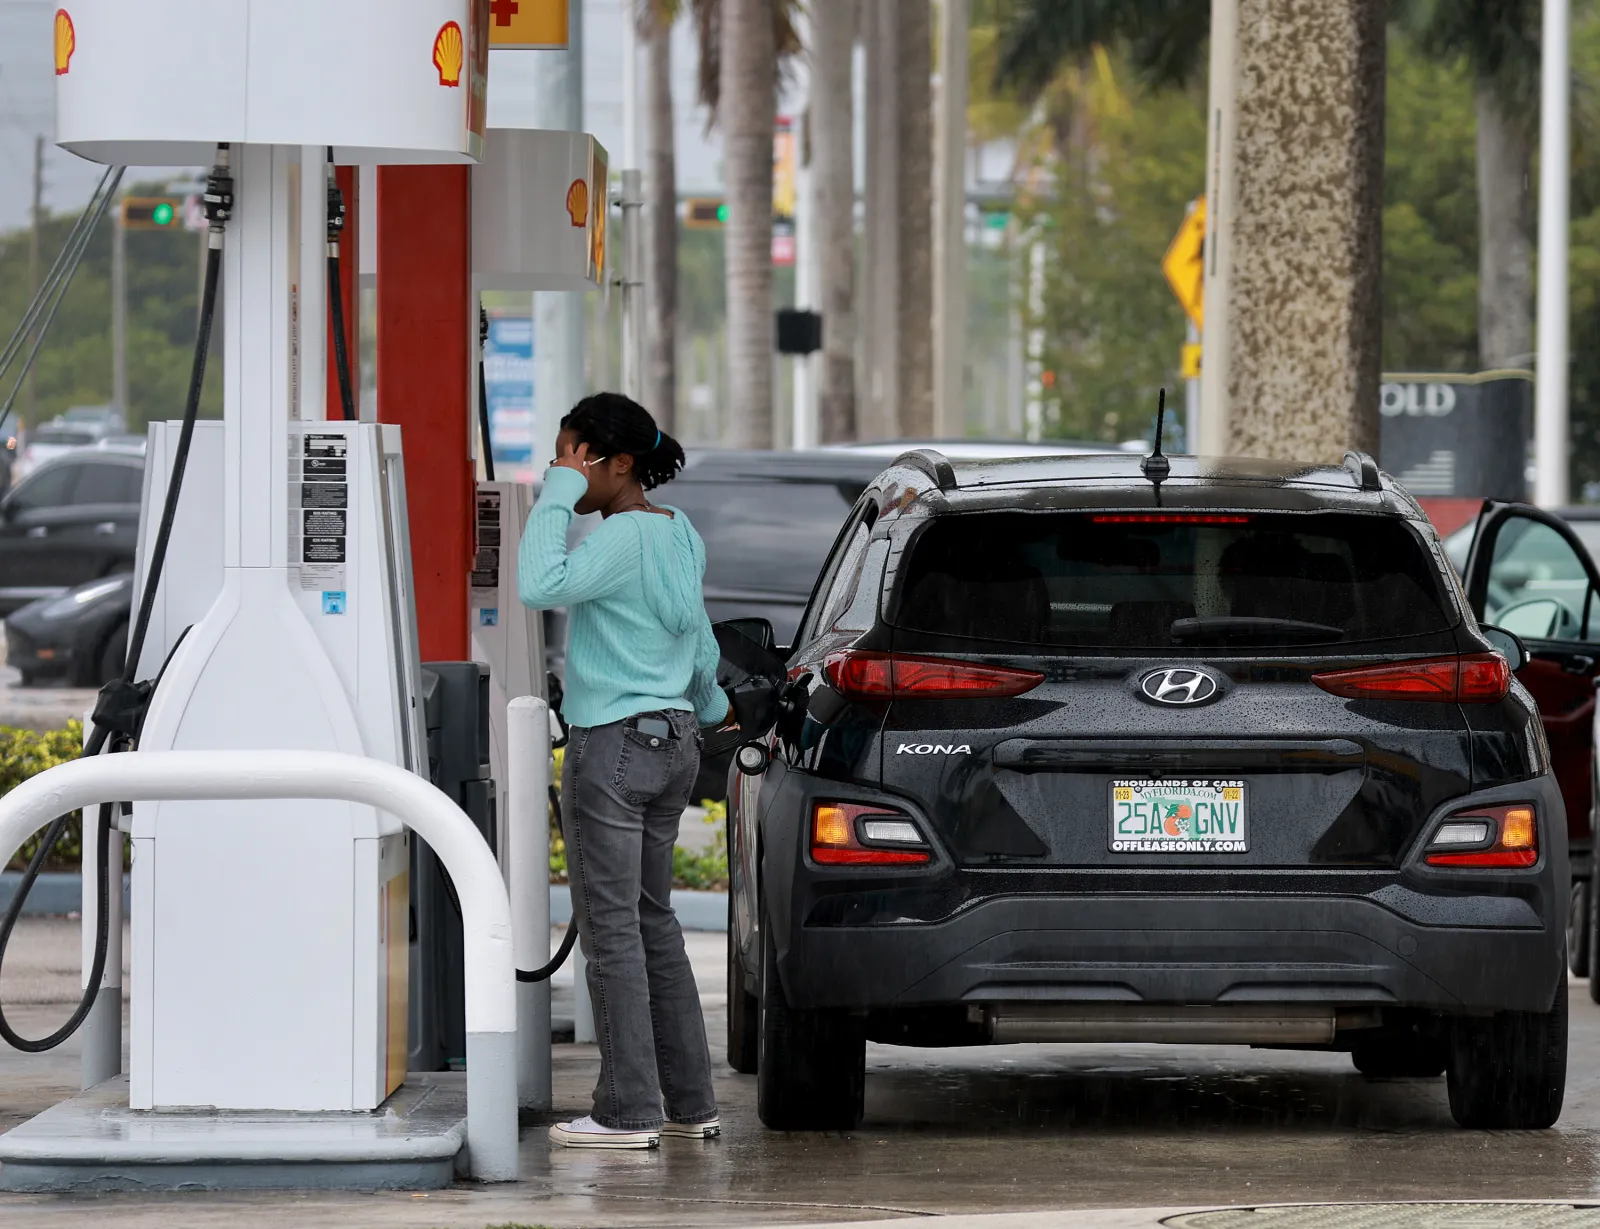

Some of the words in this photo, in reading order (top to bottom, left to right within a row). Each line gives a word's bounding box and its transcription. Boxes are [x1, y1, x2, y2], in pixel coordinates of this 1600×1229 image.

[896, 743, 972, 755] KONA
[1118, 802, 1163, 834] 25A
[1195, 802, 1239, 834] GNV
[1112, 841, 1246, 851] OFFLEASEONLY.COM
